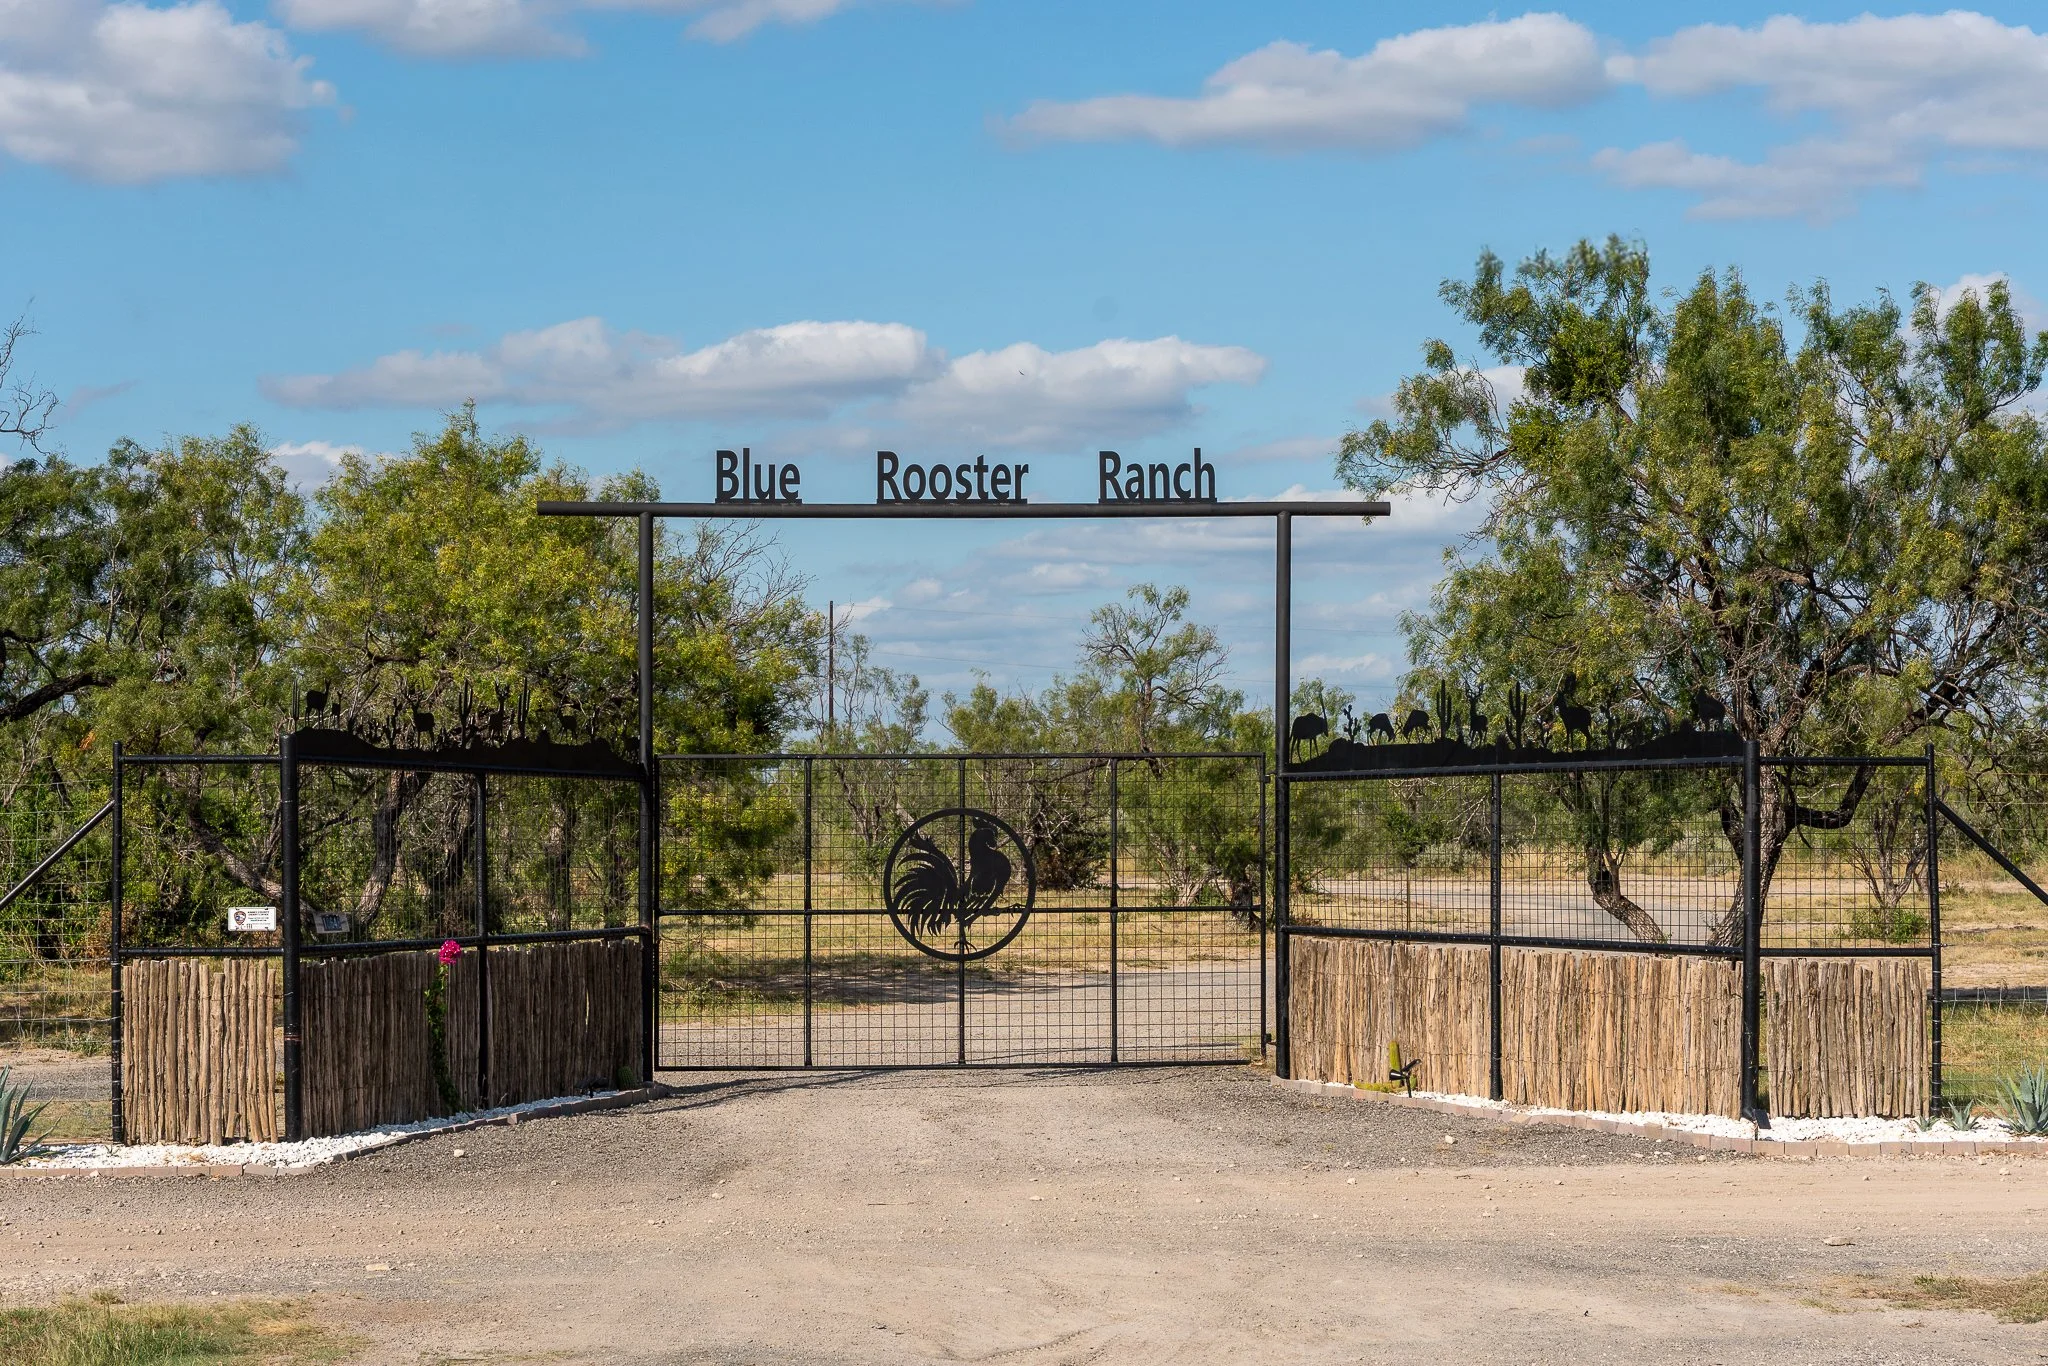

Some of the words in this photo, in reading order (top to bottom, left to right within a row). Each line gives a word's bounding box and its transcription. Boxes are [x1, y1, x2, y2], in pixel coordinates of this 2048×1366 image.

[716, 448, 801, 500] Blue
[877, 451, 1029, 500] Rooster
[1099, 448, 1216, 500] Ranch
